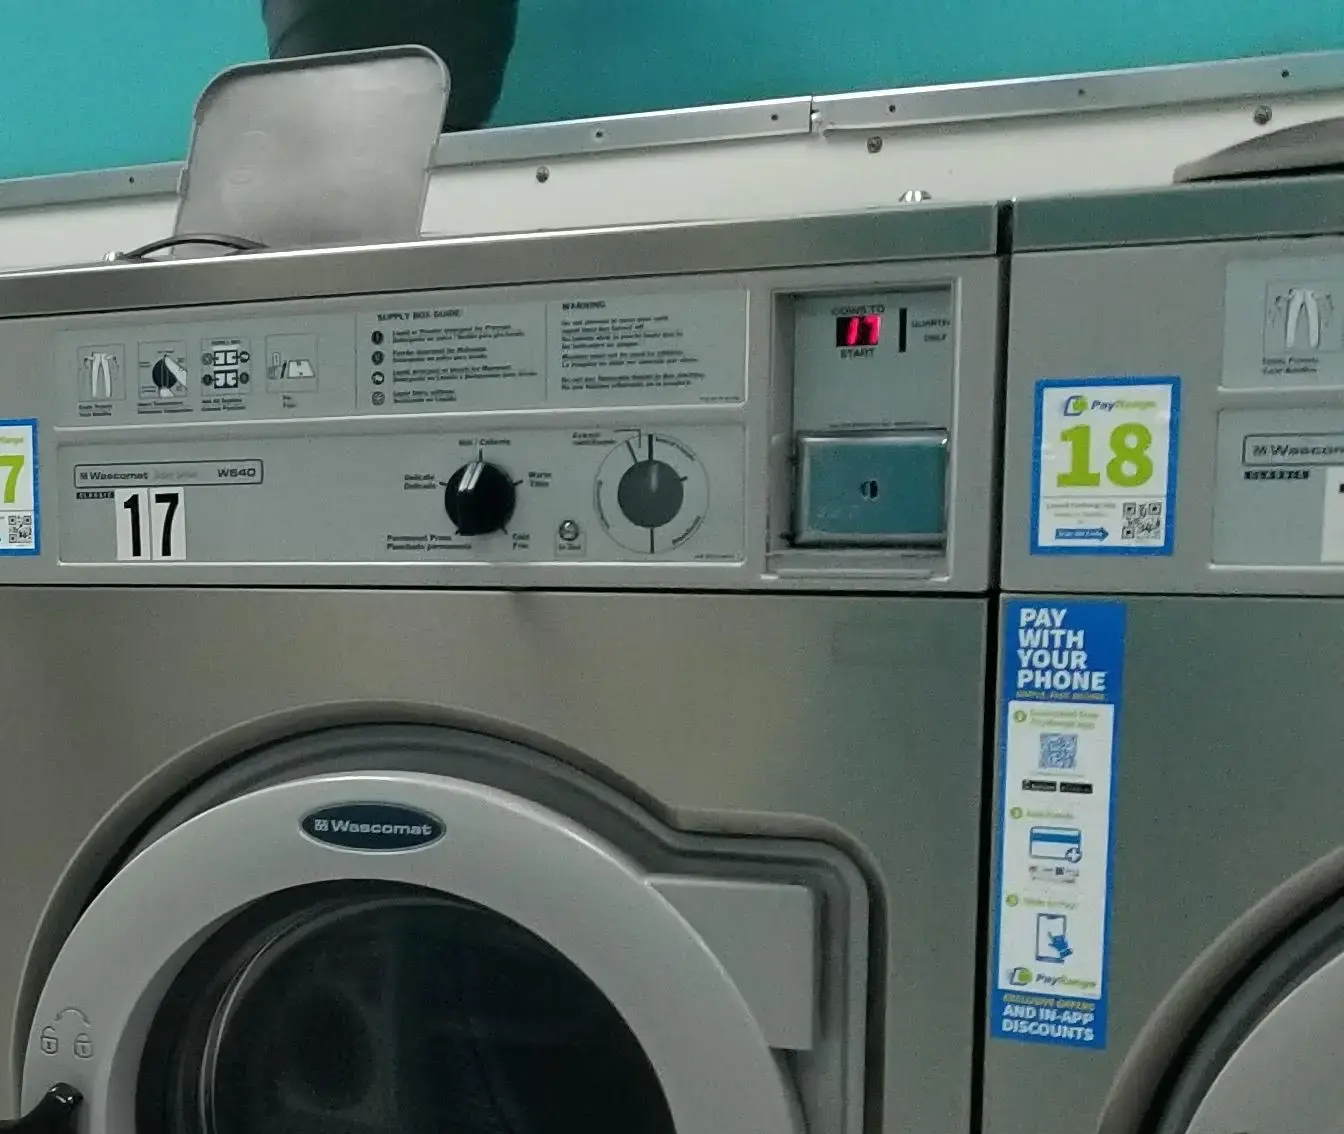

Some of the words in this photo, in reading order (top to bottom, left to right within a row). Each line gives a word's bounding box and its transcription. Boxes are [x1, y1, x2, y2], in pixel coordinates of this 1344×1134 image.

[871, 304, 885, 314] TO
[1056, 422, 1153, 487] 18
[124, 493, 179, 556] 17
[1020, 608, 1067, 627] PAY
[1018, 629, 1084, 649] WITH
[1017, 649, 1088, 670] YOUR
[1017, 669, 1108, 691] PHONE
[331, 819, 432, 836] Wascomat
[1003, 1005, 1037, 1019] AND
[1039, 1007, 1094, 1025] IN-APP
[1002, 1018, 1095, 1041] DISCOUNTS
